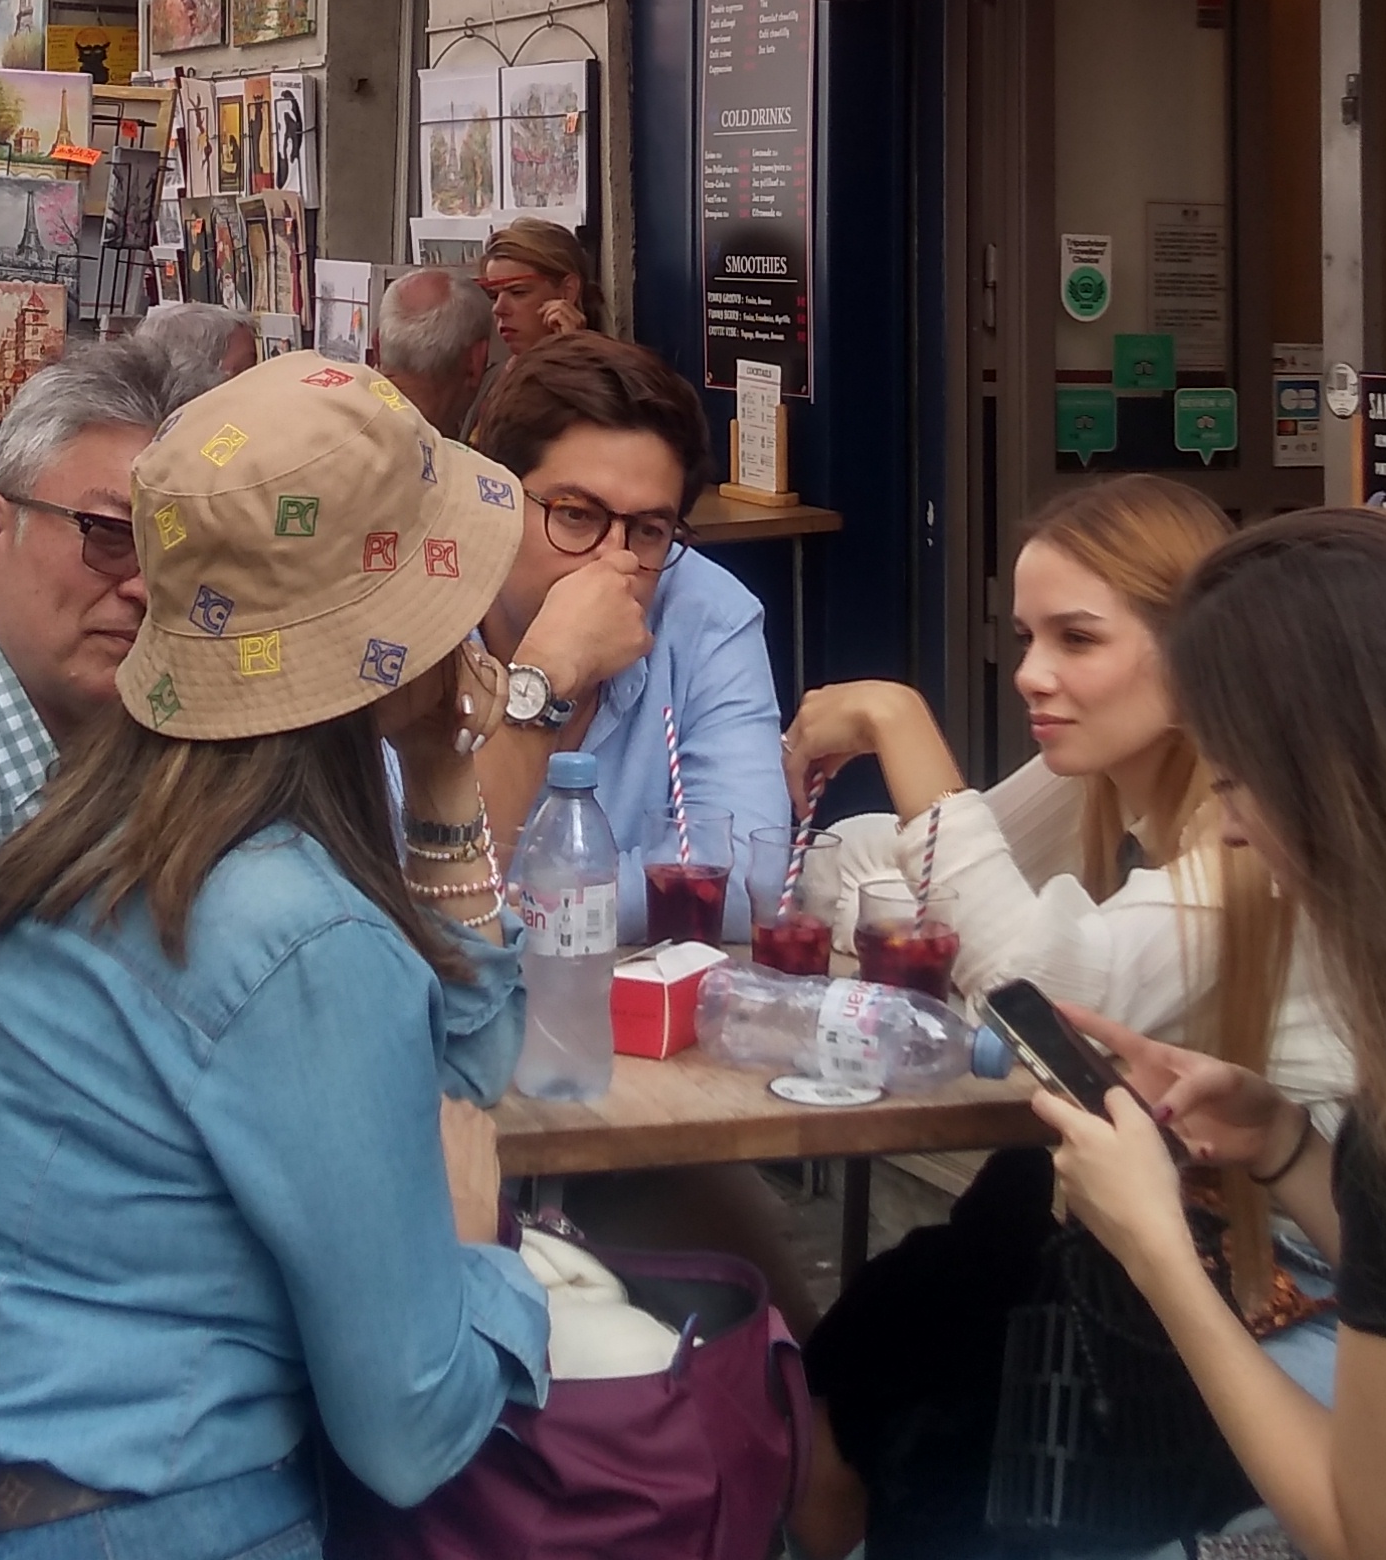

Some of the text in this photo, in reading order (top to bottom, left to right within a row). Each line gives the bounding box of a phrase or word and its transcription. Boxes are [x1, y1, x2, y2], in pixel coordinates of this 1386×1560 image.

[721, 107, 792, 128] COLD DRINKS
[725, 255, 787, 274] SMOOTHIES
